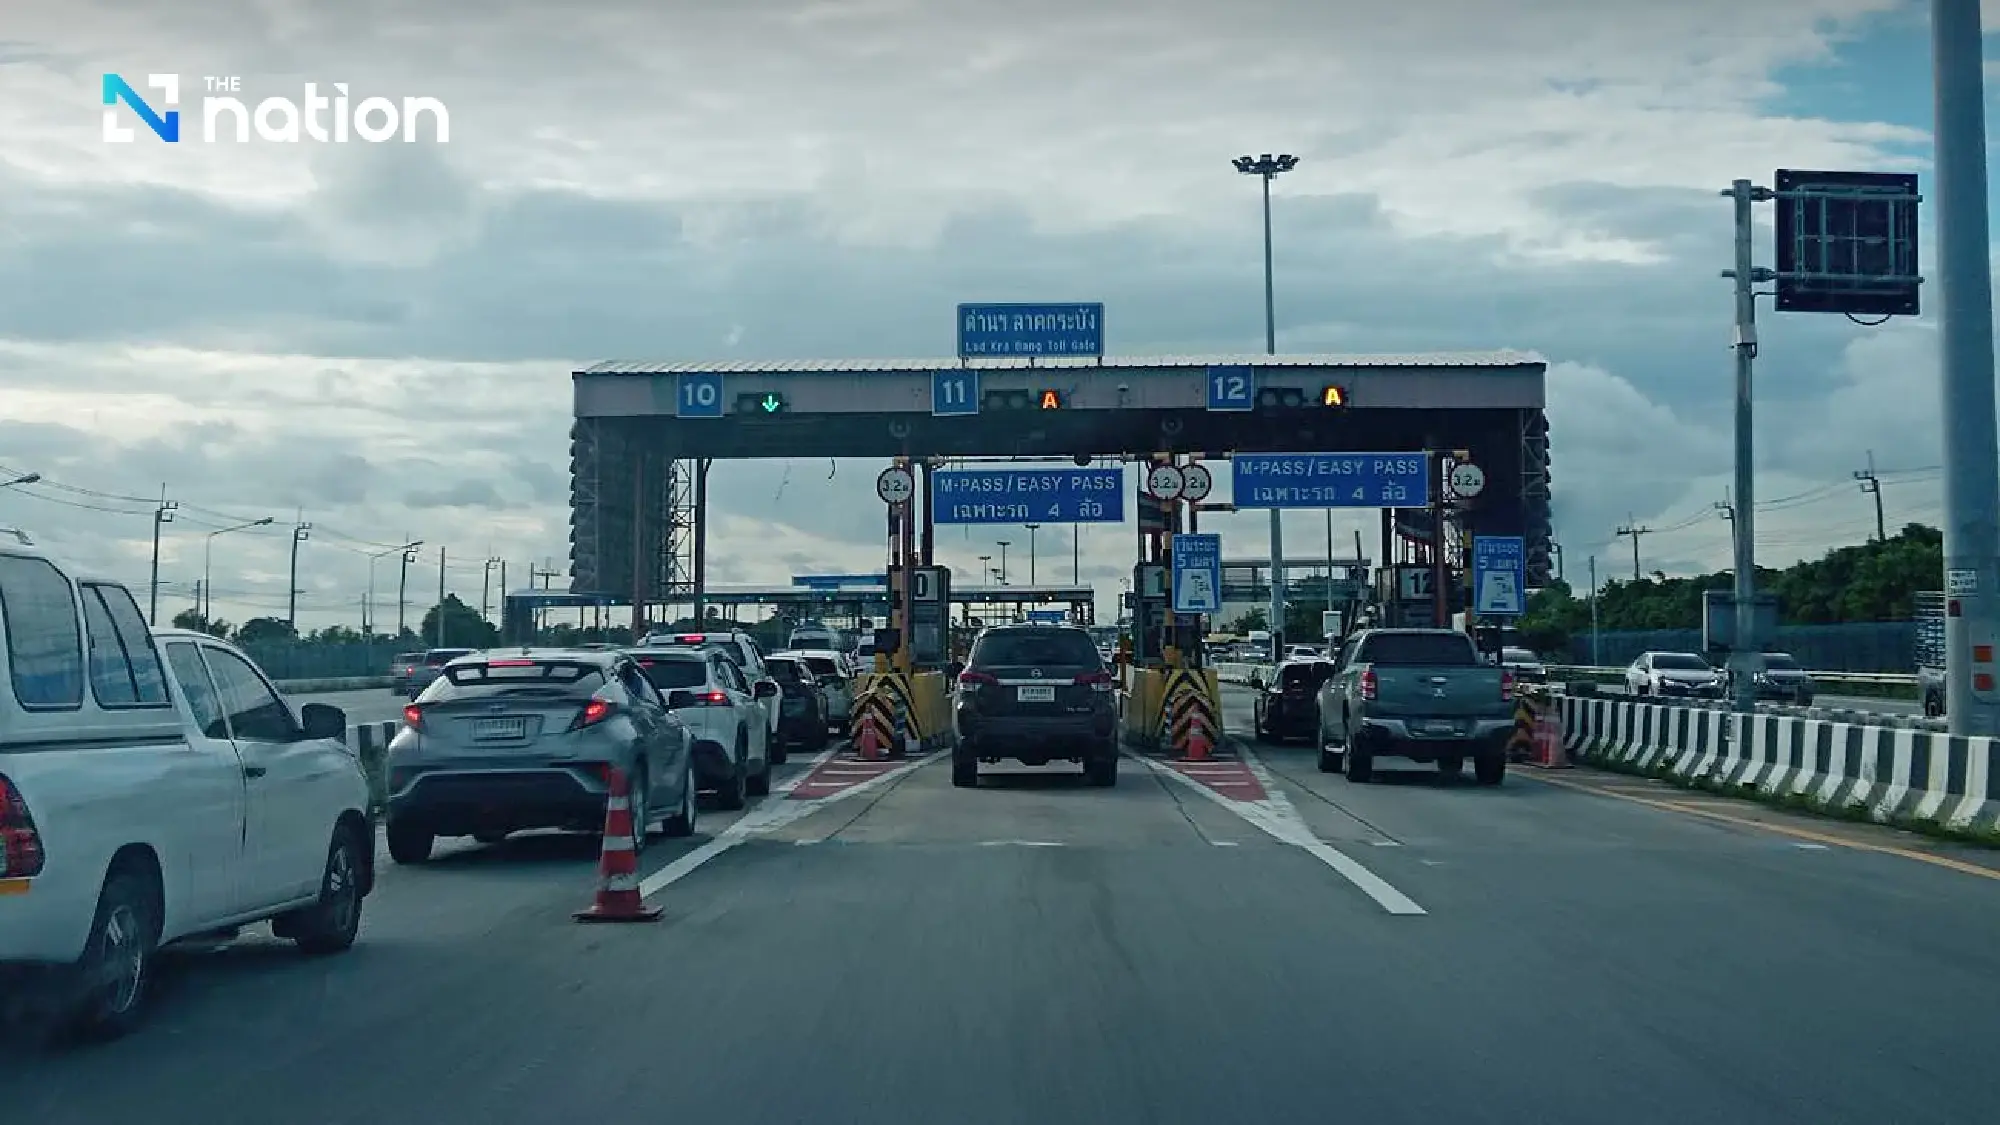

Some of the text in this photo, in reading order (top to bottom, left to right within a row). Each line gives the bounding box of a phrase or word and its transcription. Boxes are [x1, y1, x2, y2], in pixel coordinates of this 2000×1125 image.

[684, 383, 716, 406] 10
[942, 380, 965, 403] 11
[1214, 376, 1246, 400] 12
[1325, 388, 1342, 406] A
[1042, 391, 1058, 409] A
[1240, 459, 1418, 476] M-PASS/EASY PASS
[941, 474, 1115, 492] M-PASS/EASY PASS
[1352, 488, 1364, 500] 4
[1048, 503, 1060, 518] 4
[1177, 554, 1187, 568] 5
[1479, 556, 1489, 569] 5
